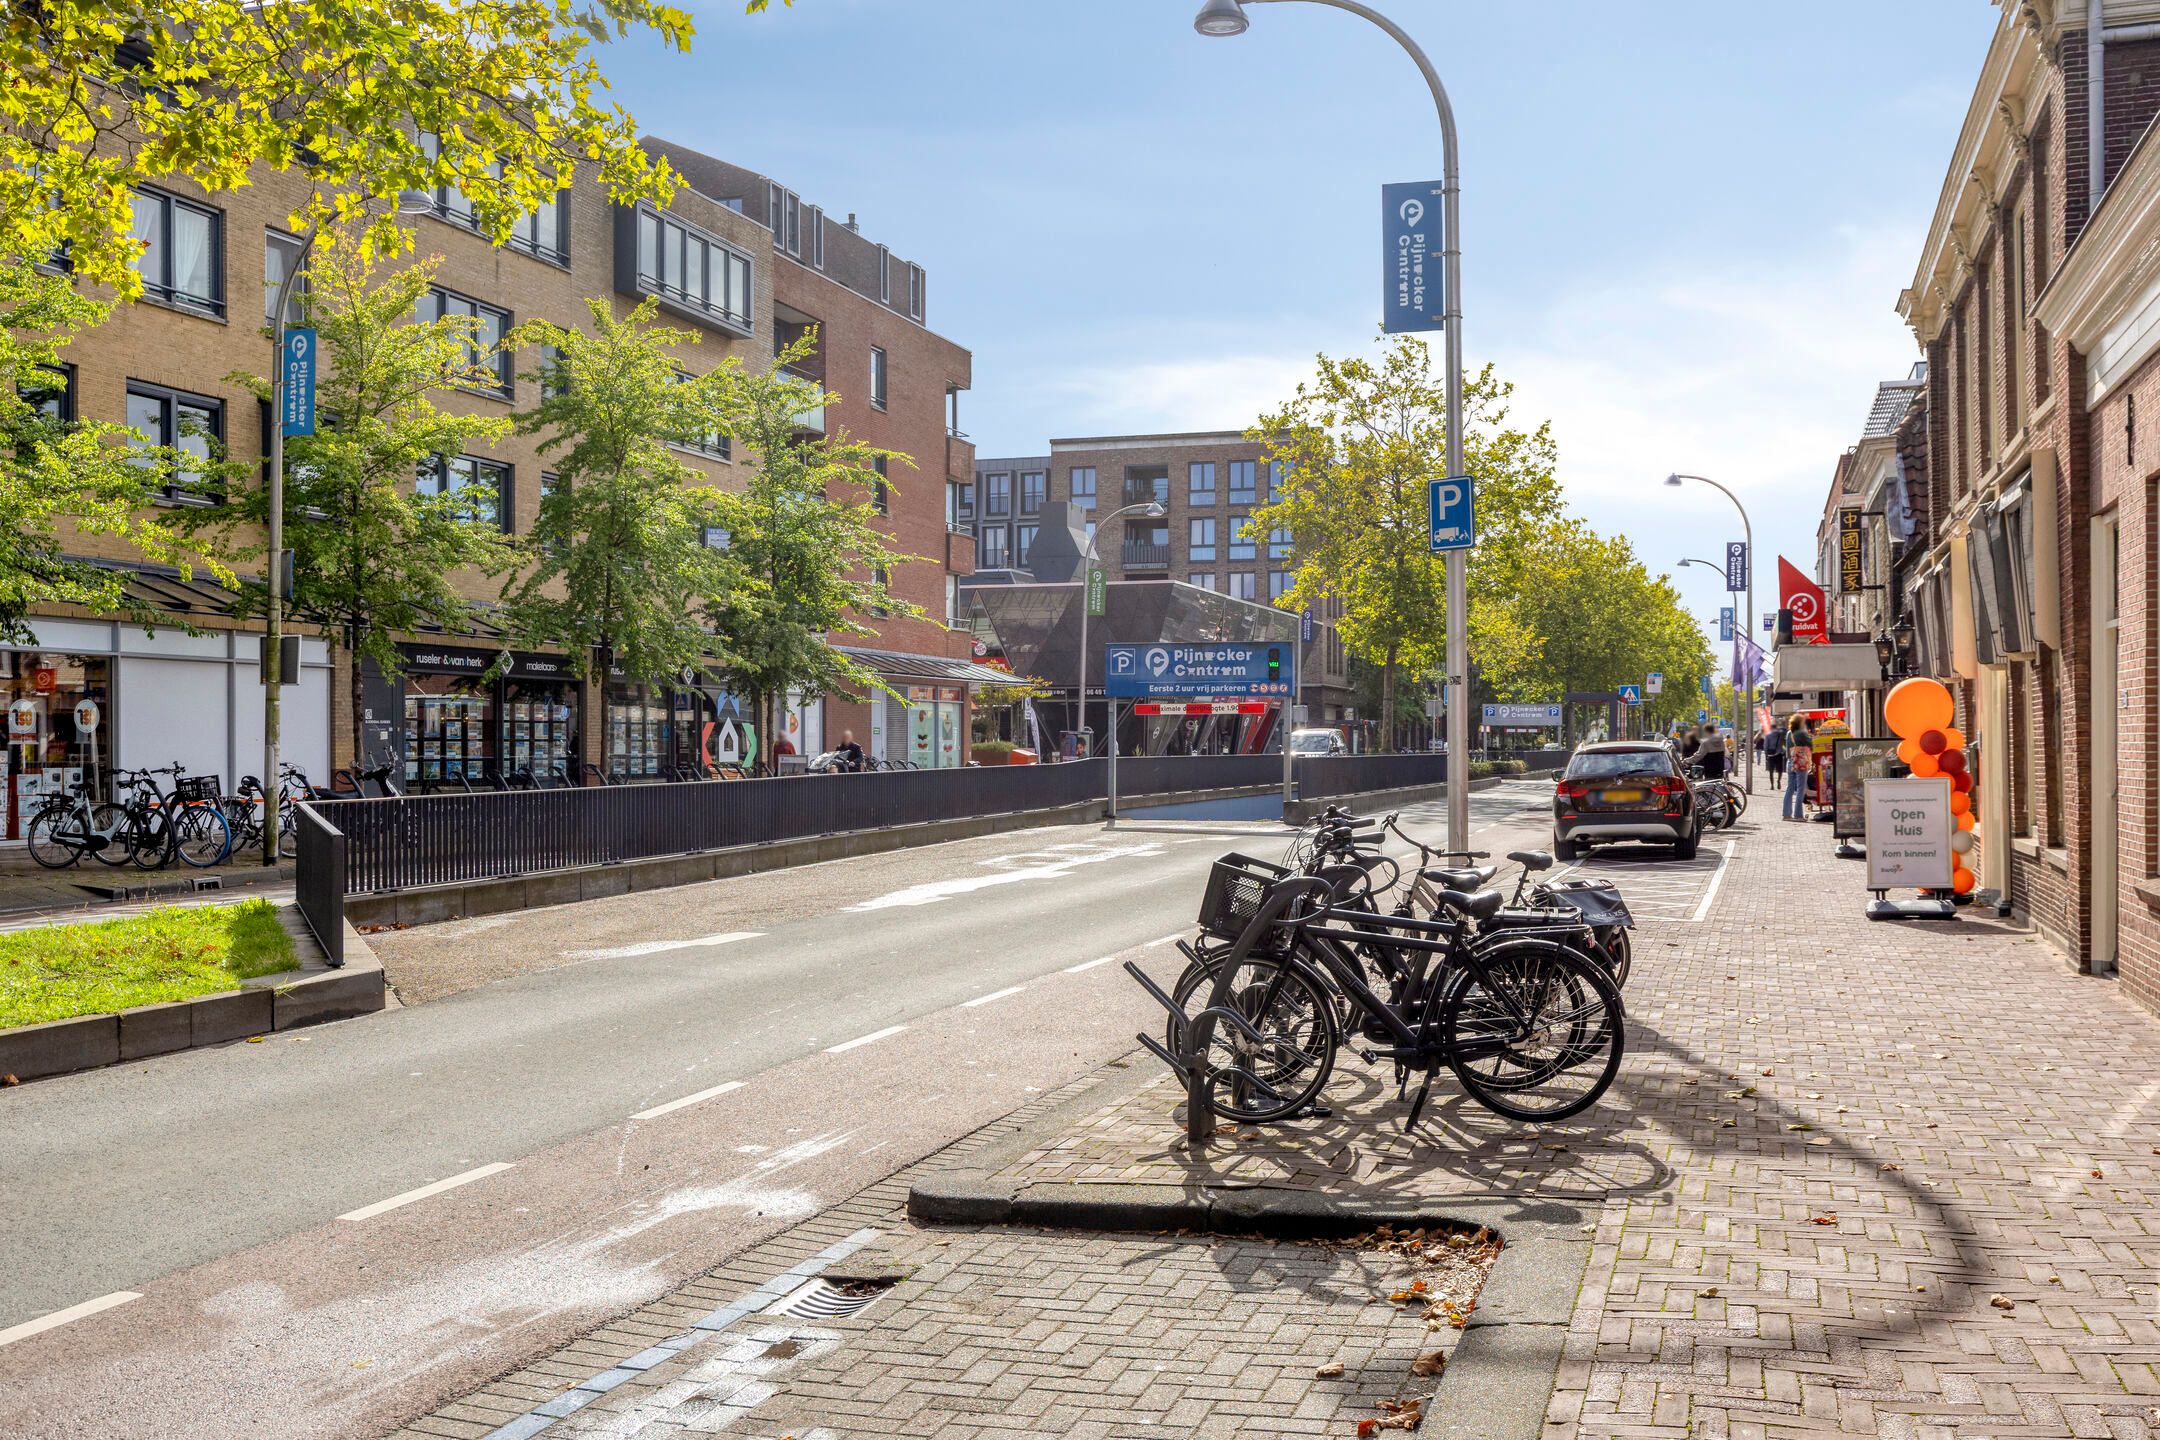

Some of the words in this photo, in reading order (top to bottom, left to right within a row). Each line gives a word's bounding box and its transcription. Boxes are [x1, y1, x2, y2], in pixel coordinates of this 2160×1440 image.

[1398, 235, 1411, 307] Cntrm
[1411, 233, 1426, 312] Pijncker
[289, 362, 299, 423] Cntrm
[298, 361, 308, 428] Pijncker
[1438, 484, 1462, 521] P
[1792, 622, 1819, 631] ruidvat
[416, 654, 440, 665] ruseler
[451, 657, 465, 666] van
[467, 656, 482, 667] herk
[1174, 649, 1252, 665] Pijncker
[526, 662, 555, 671] makelaars
[1118, 656, 1130, 673] P
[1174, 664, 1246, 676] Cntrm
[1196, 685, 1209, 693] vrij
[1210, 685, 1247, 693] parkeren
[1152, 704, 1181, 712] Maximale
[1890, 808, 1926, 823] Open
[1894, 825, 1923, 836] Huis
[1882, 850, 1902, 858] Kom
[1904, 849, 1937, 858] binnen!
